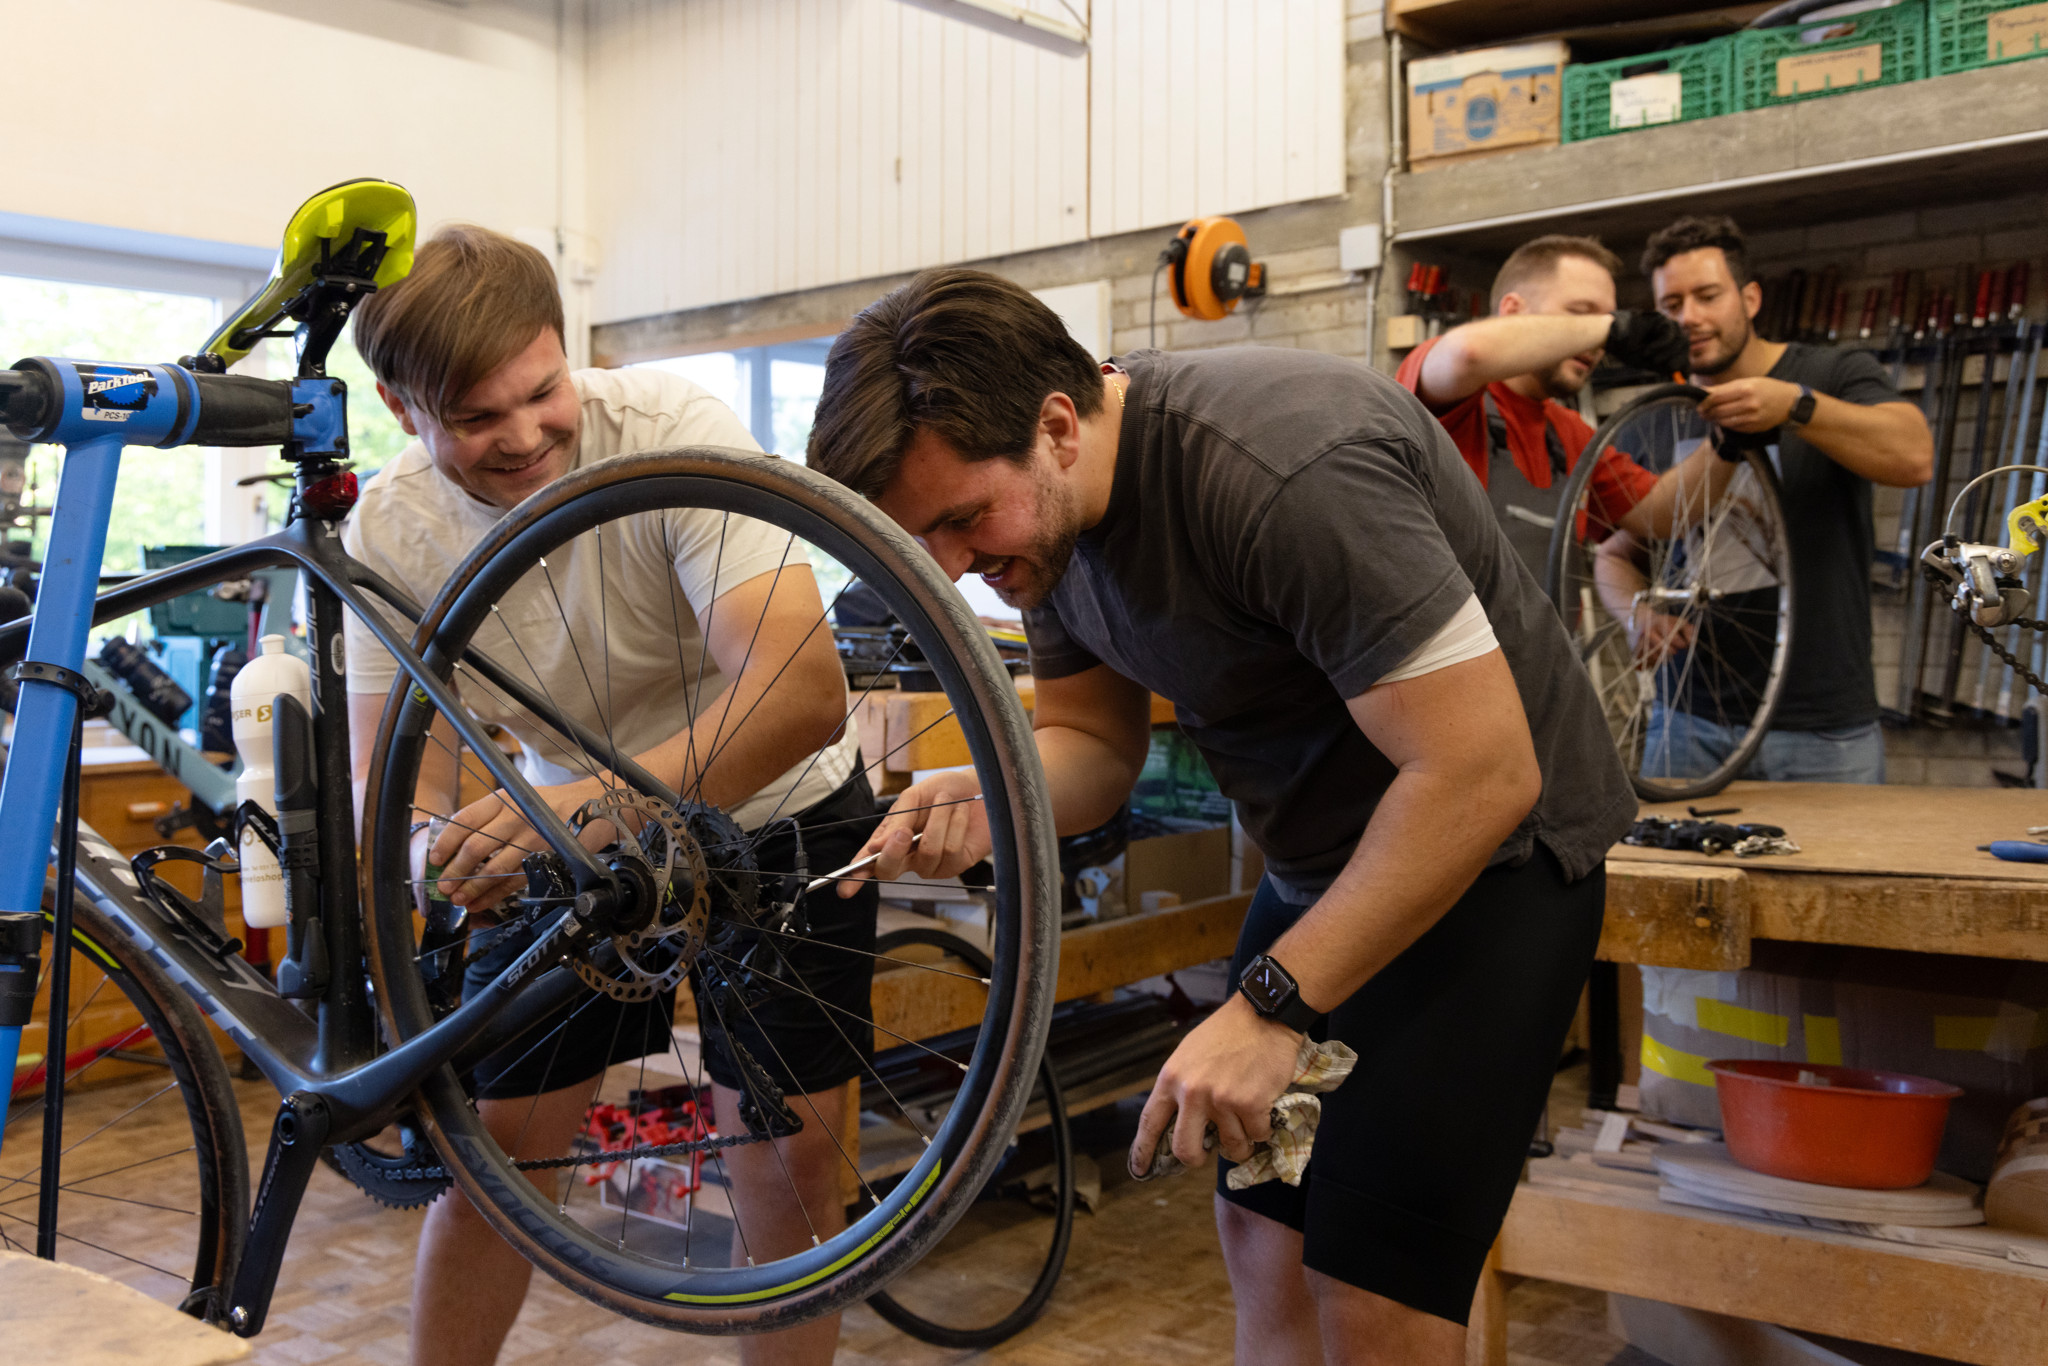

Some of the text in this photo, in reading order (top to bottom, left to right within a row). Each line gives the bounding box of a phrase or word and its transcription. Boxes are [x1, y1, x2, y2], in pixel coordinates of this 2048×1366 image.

[118, 702, 181, 778] YON
[506, 930, 562, 988] SCOTT
[453, 1137, 620, 1277] SYNCROS
